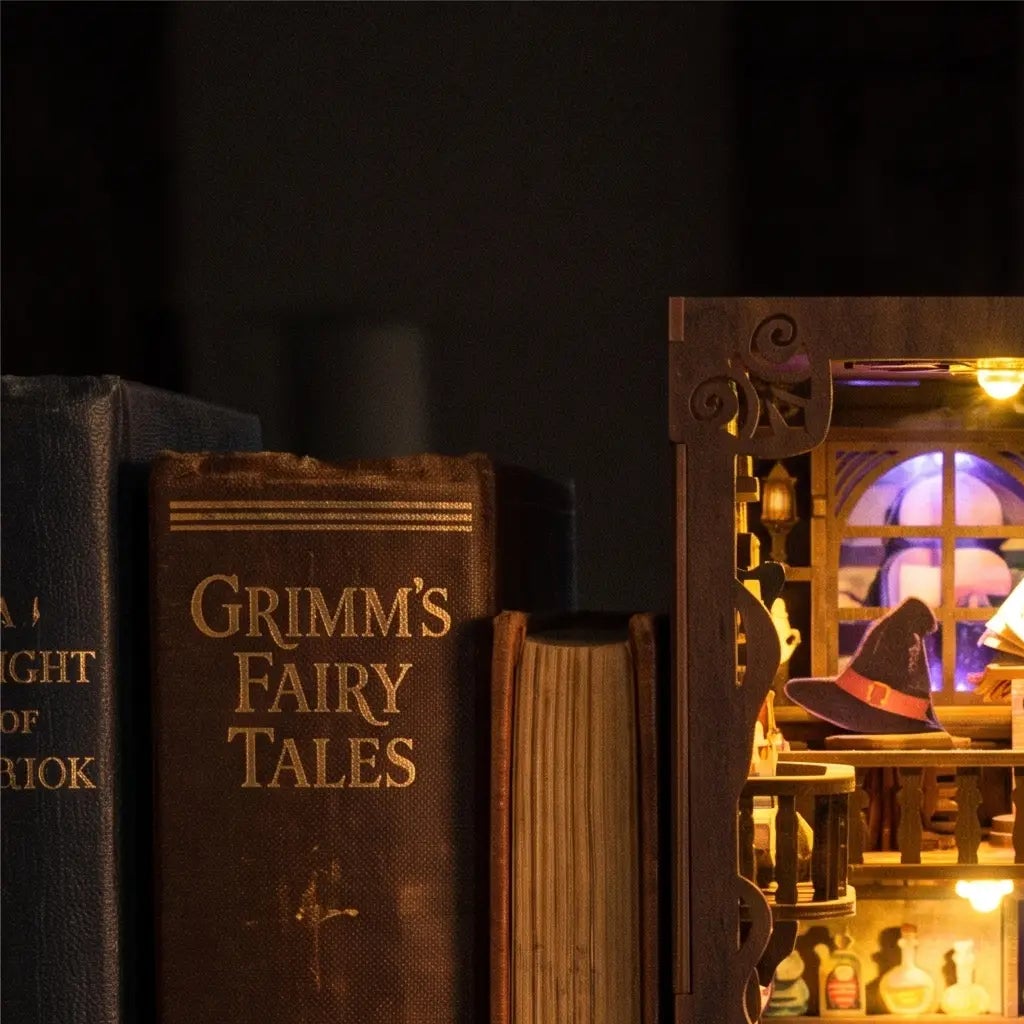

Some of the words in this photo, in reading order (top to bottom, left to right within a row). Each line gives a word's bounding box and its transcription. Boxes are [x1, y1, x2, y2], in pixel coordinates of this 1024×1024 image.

[190, 574, 451, 649] GRIMM'S
[0, 709, 39, 734] OF
[233, 652, 413, 726] FAIRY
[228, 727, 416, 788] TALES
